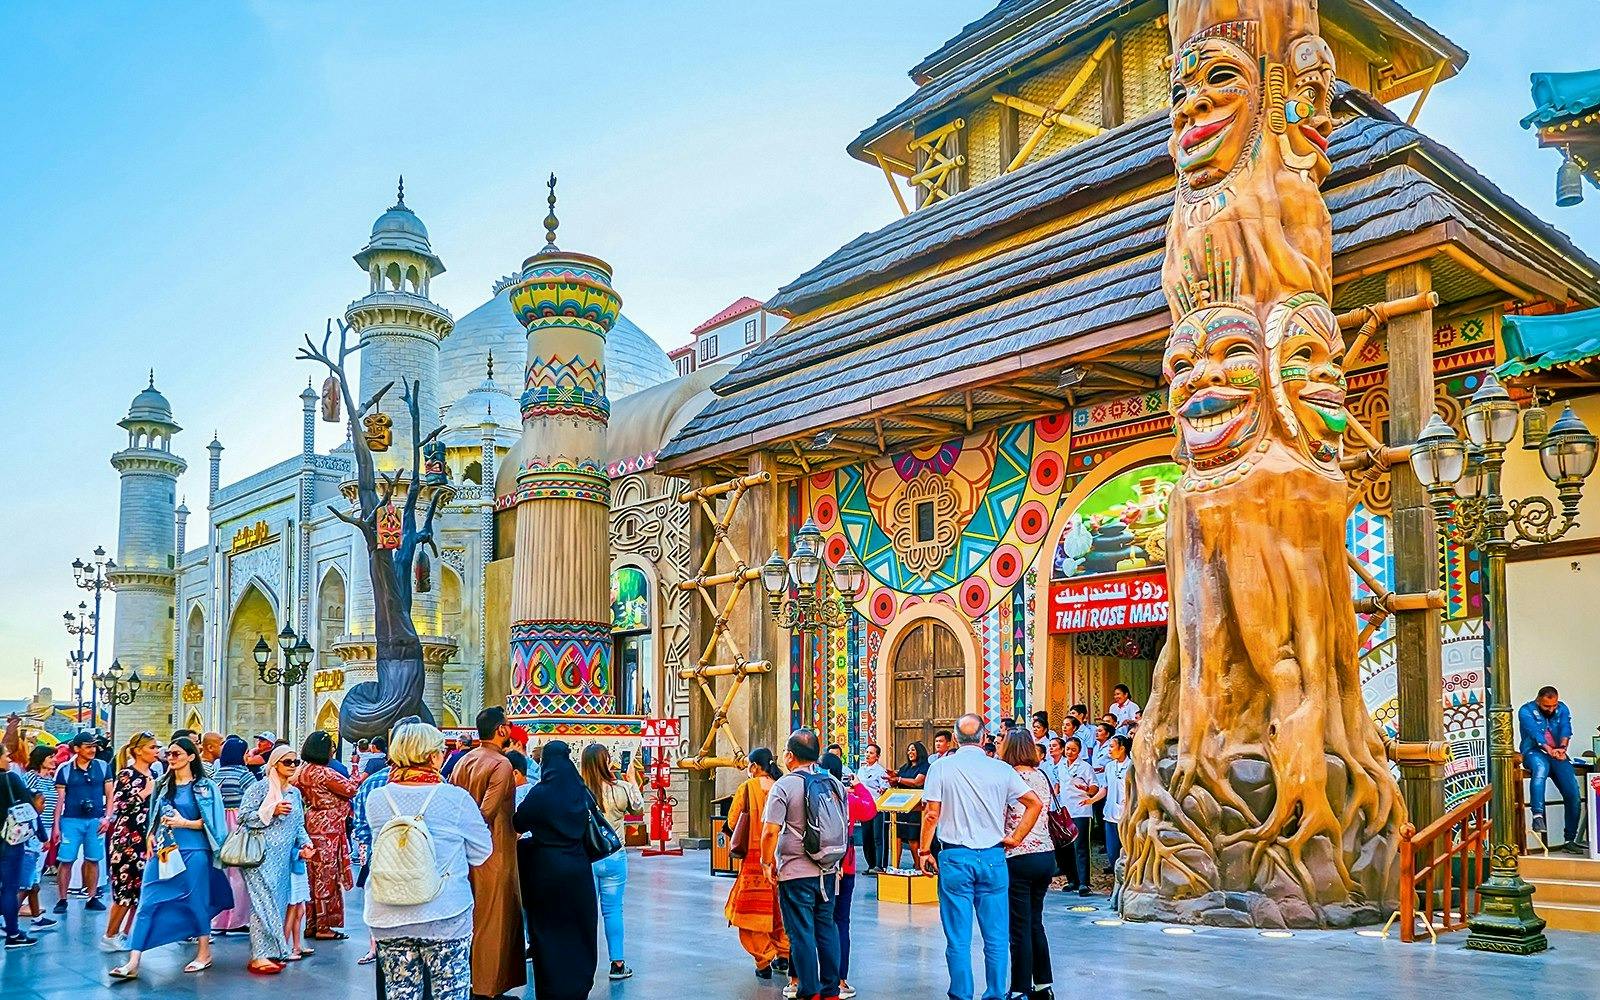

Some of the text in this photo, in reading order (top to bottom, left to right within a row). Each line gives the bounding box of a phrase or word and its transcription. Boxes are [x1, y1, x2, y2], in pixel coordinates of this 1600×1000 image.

[1055, 583, 1127, 608] للتدليك
[1056, 610, 1087, 629] THAI
[1090, 607, 1126, 628] ROSE
